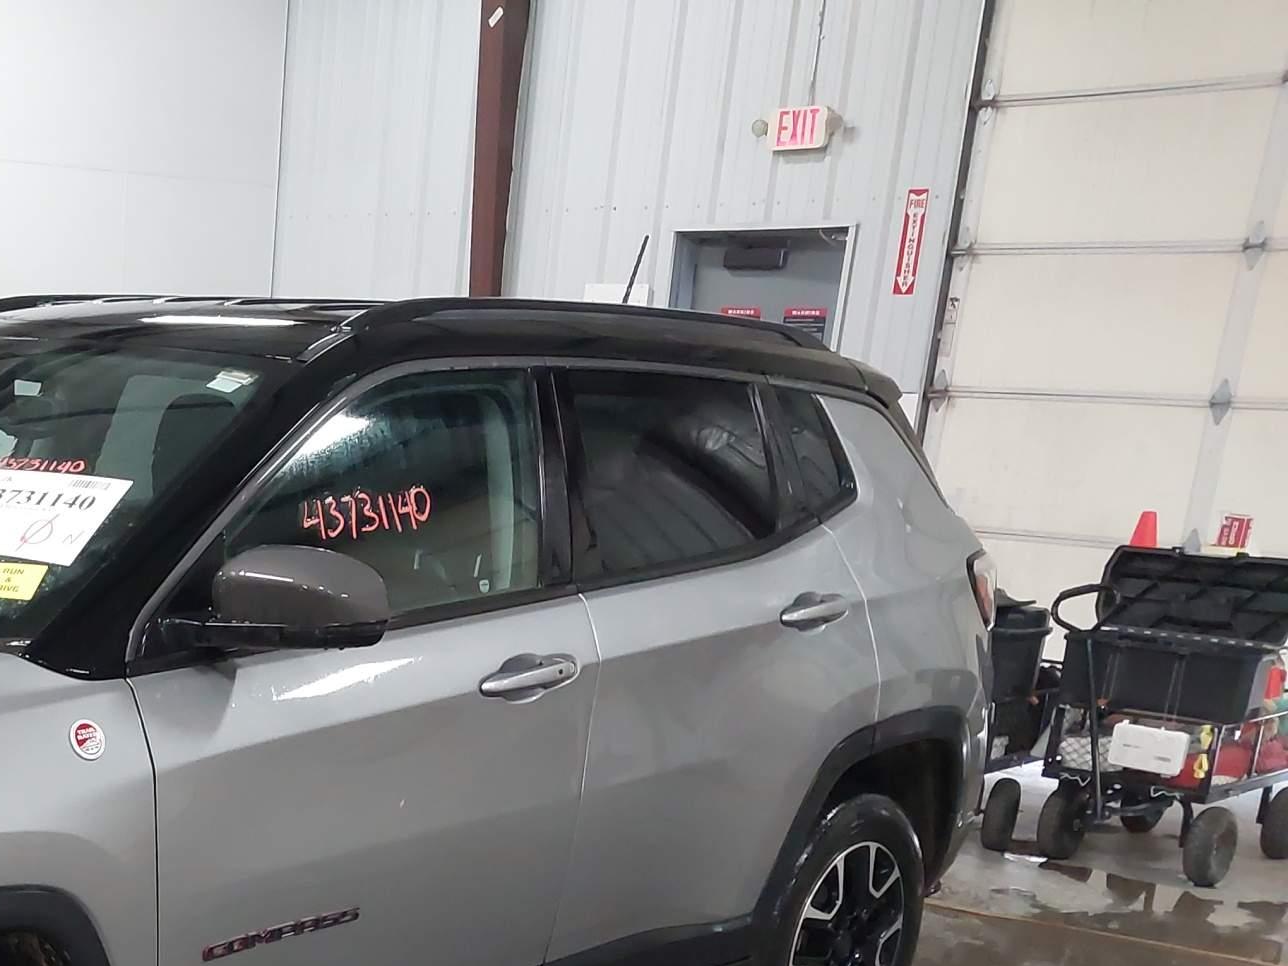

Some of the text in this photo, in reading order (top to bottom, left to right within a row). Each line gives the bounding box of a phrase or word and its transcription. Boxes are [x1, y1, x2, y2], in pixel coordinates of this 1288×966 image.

[776, 109, 820, 147] EXIT
[910, 199, 926, 208] FIRE
[302, 486, 431, 540] 43731140
